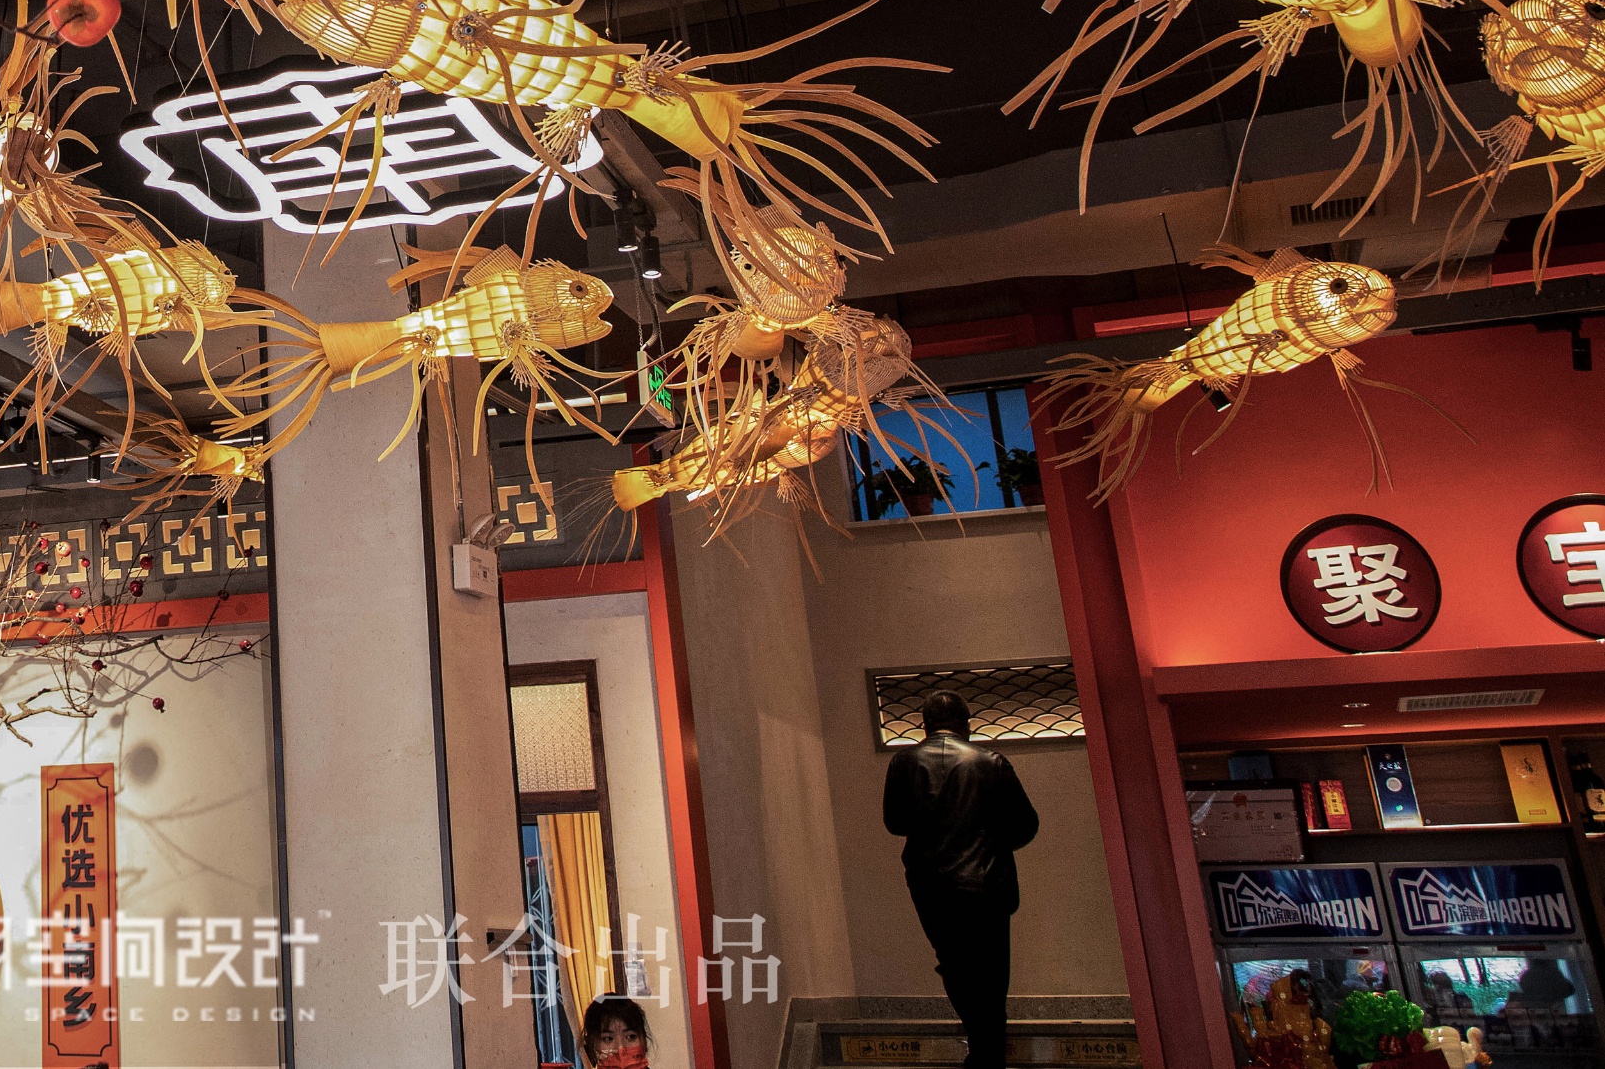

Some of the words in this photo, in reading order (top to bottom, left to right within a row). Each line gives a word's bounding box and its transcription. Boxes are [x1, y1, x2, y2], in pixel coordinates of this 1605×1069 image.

[61, 804, 97, 1028] 优选小南乡
[1300, 895, 1380, 931] HARBIN
[1488, 892, 1572, 930] HARBIN
